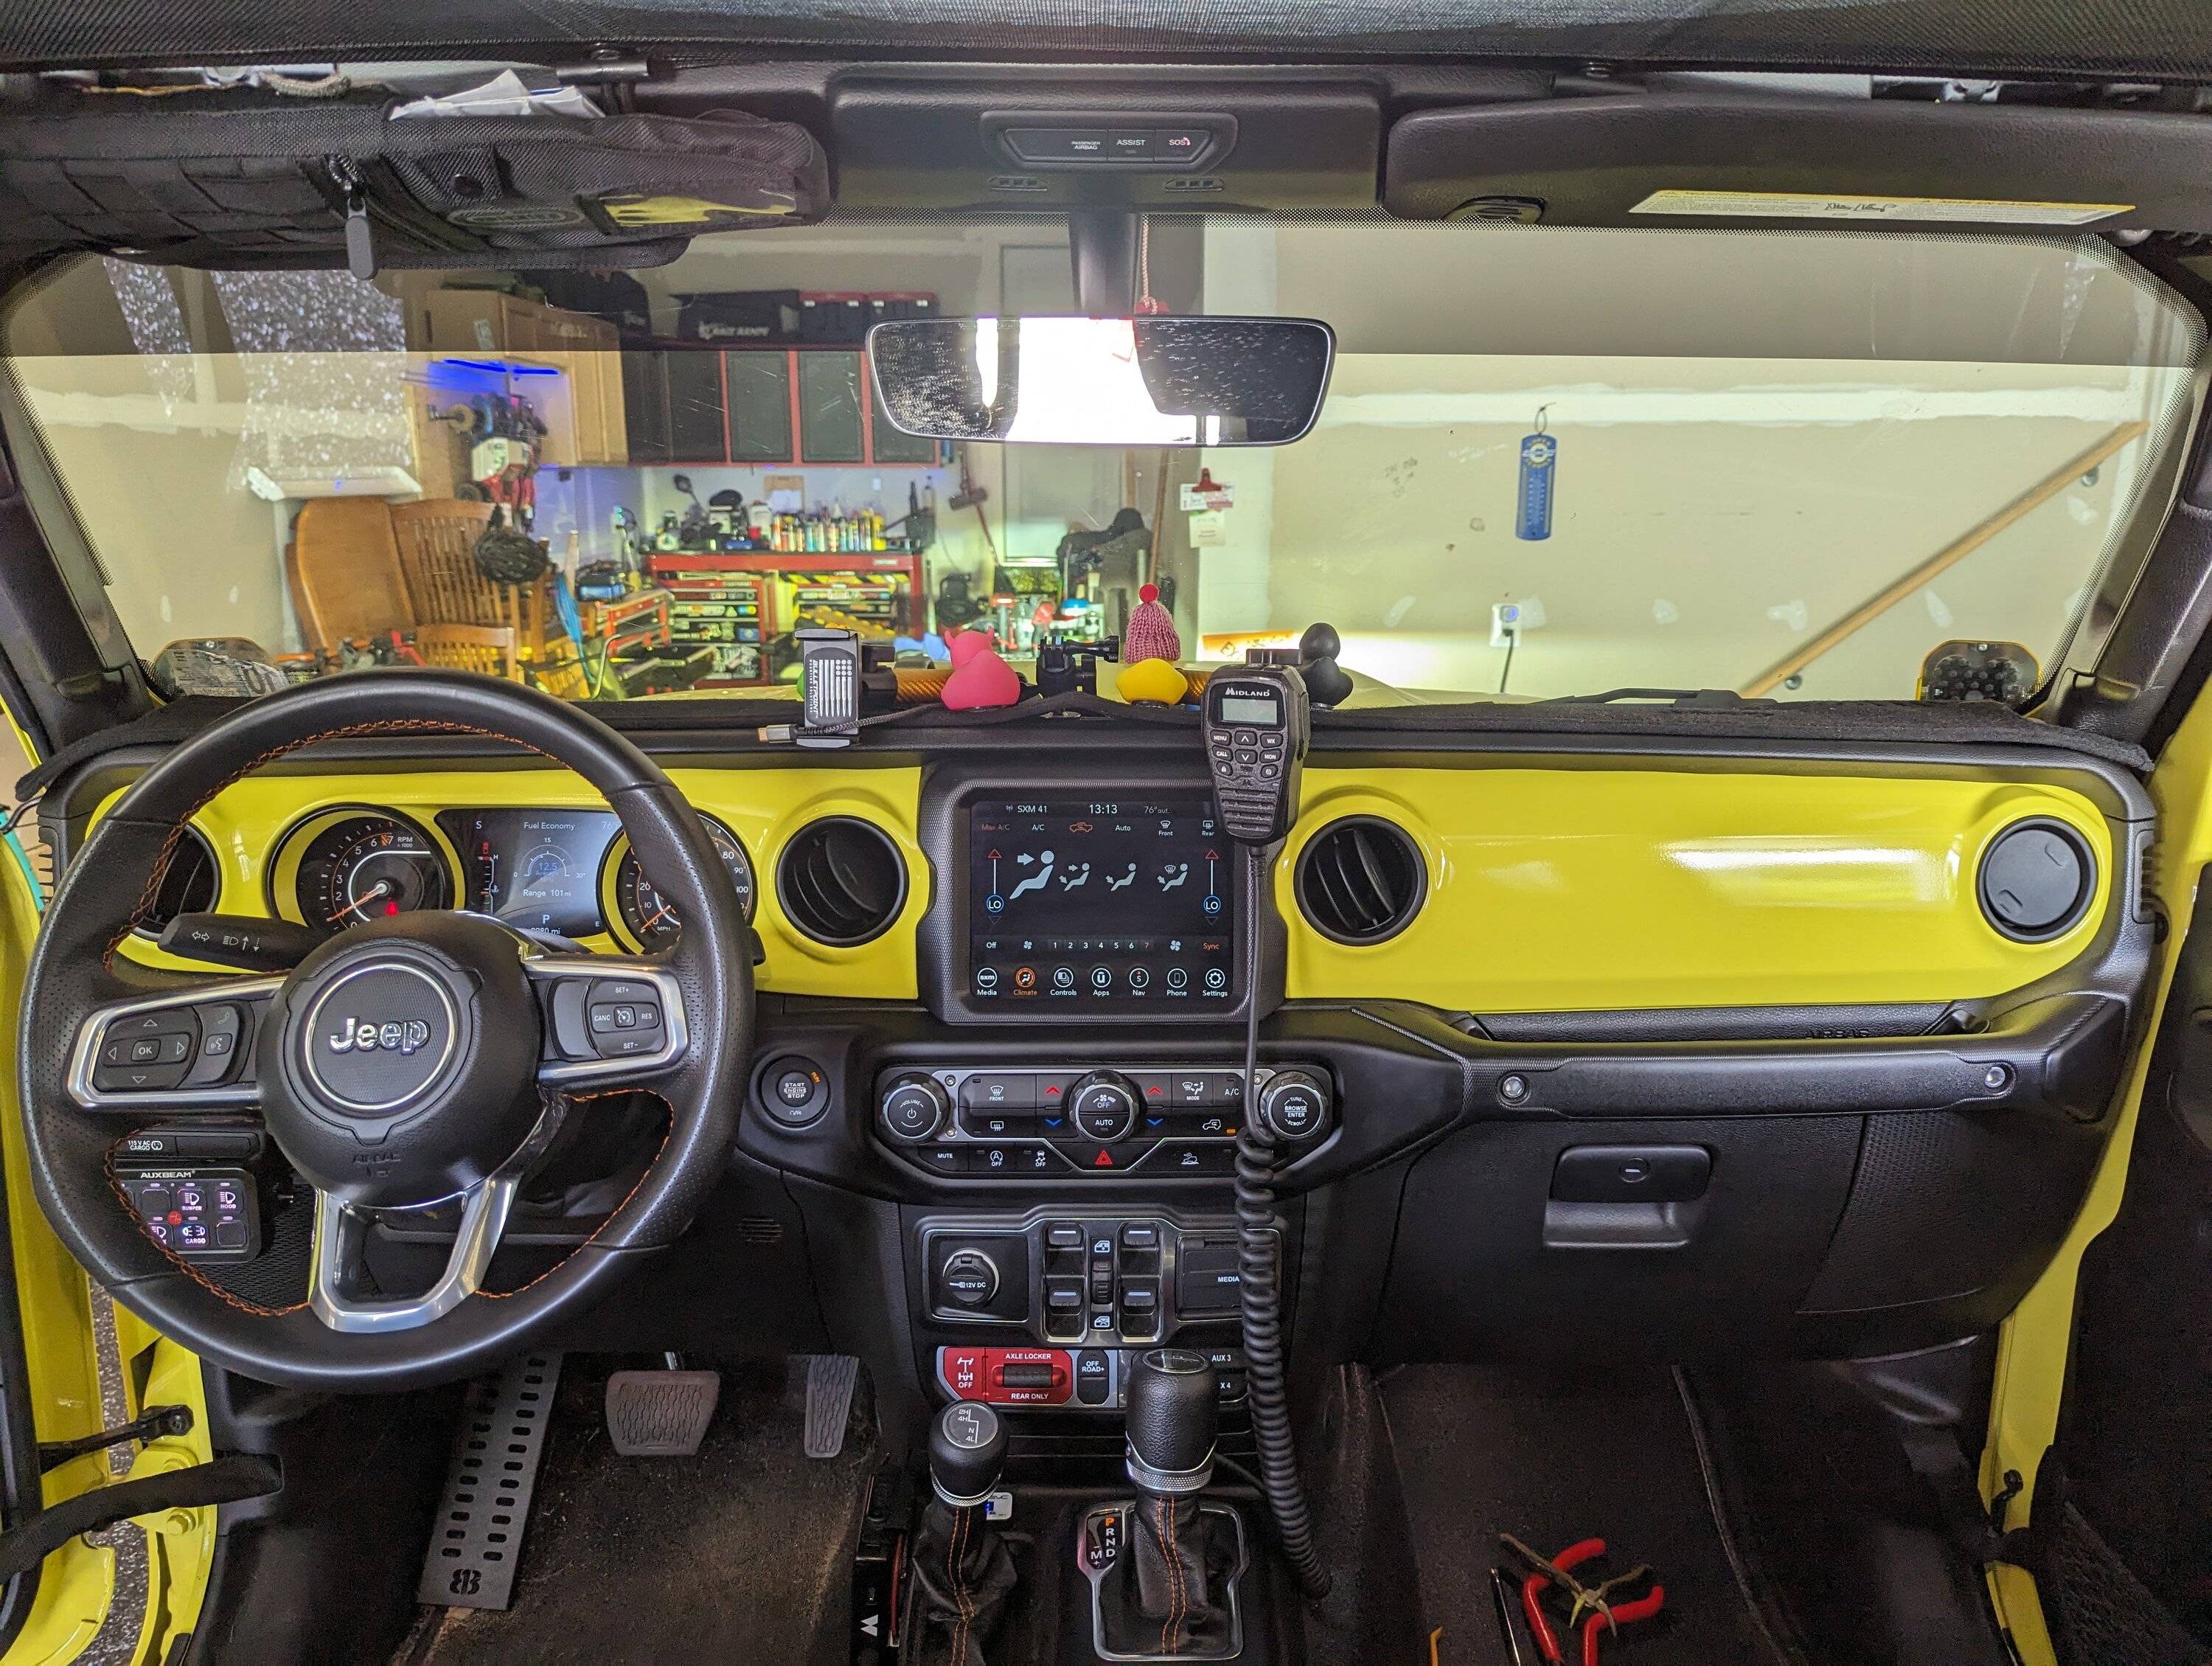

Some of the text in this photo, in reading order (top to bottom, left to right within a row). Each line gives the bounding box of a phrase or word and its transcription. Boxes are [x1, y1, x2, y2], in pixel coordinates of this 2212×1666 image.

[1225, 687, 1270, 697] MIDLAND
[1088, 804, 1118, 814] 13:13
[476, 821, 482, 830] S
[524, 822, 575, 831] Fuel Economy
[370, 838, 378, 847] 6
[355, 846, 362, 855] 5
[723, 851, 734, 860] 80
[343, 859, 349, 868] 4
[335, 875, 343, 884] 3
[639, 882, 651, 891] 20
[335, 892, 342, 900] 2
[523, 889, 546, 898] Range
[988, 900, 1001, 909] LO
[1206, 901, 1219, 910] LO
[543, 914, 549, 924] P
[552, 927, 560, 935] mi
[986, 941, 997, 949] Off
[1203, 943, 1220, 951] Sync
[1093, 989, 1110, 997] Apps
[1202, 989, 1228, 997] Settings
[330, 1016, 430, 1055] Jeep
[139, 1047, 152, 1055] OK
[1225, 1088, 1239, 1097] A/C
[1211, 1354, 1225, 1362] AUX
[1105, 1517, 1115, 1526] P
[1106, 1527, 1115, 1536] R
[1106, 1538, 1116, 1547] N
[1091, 1550, 1102, 1560] M
[1106, 1549, 1116, 1558] D
